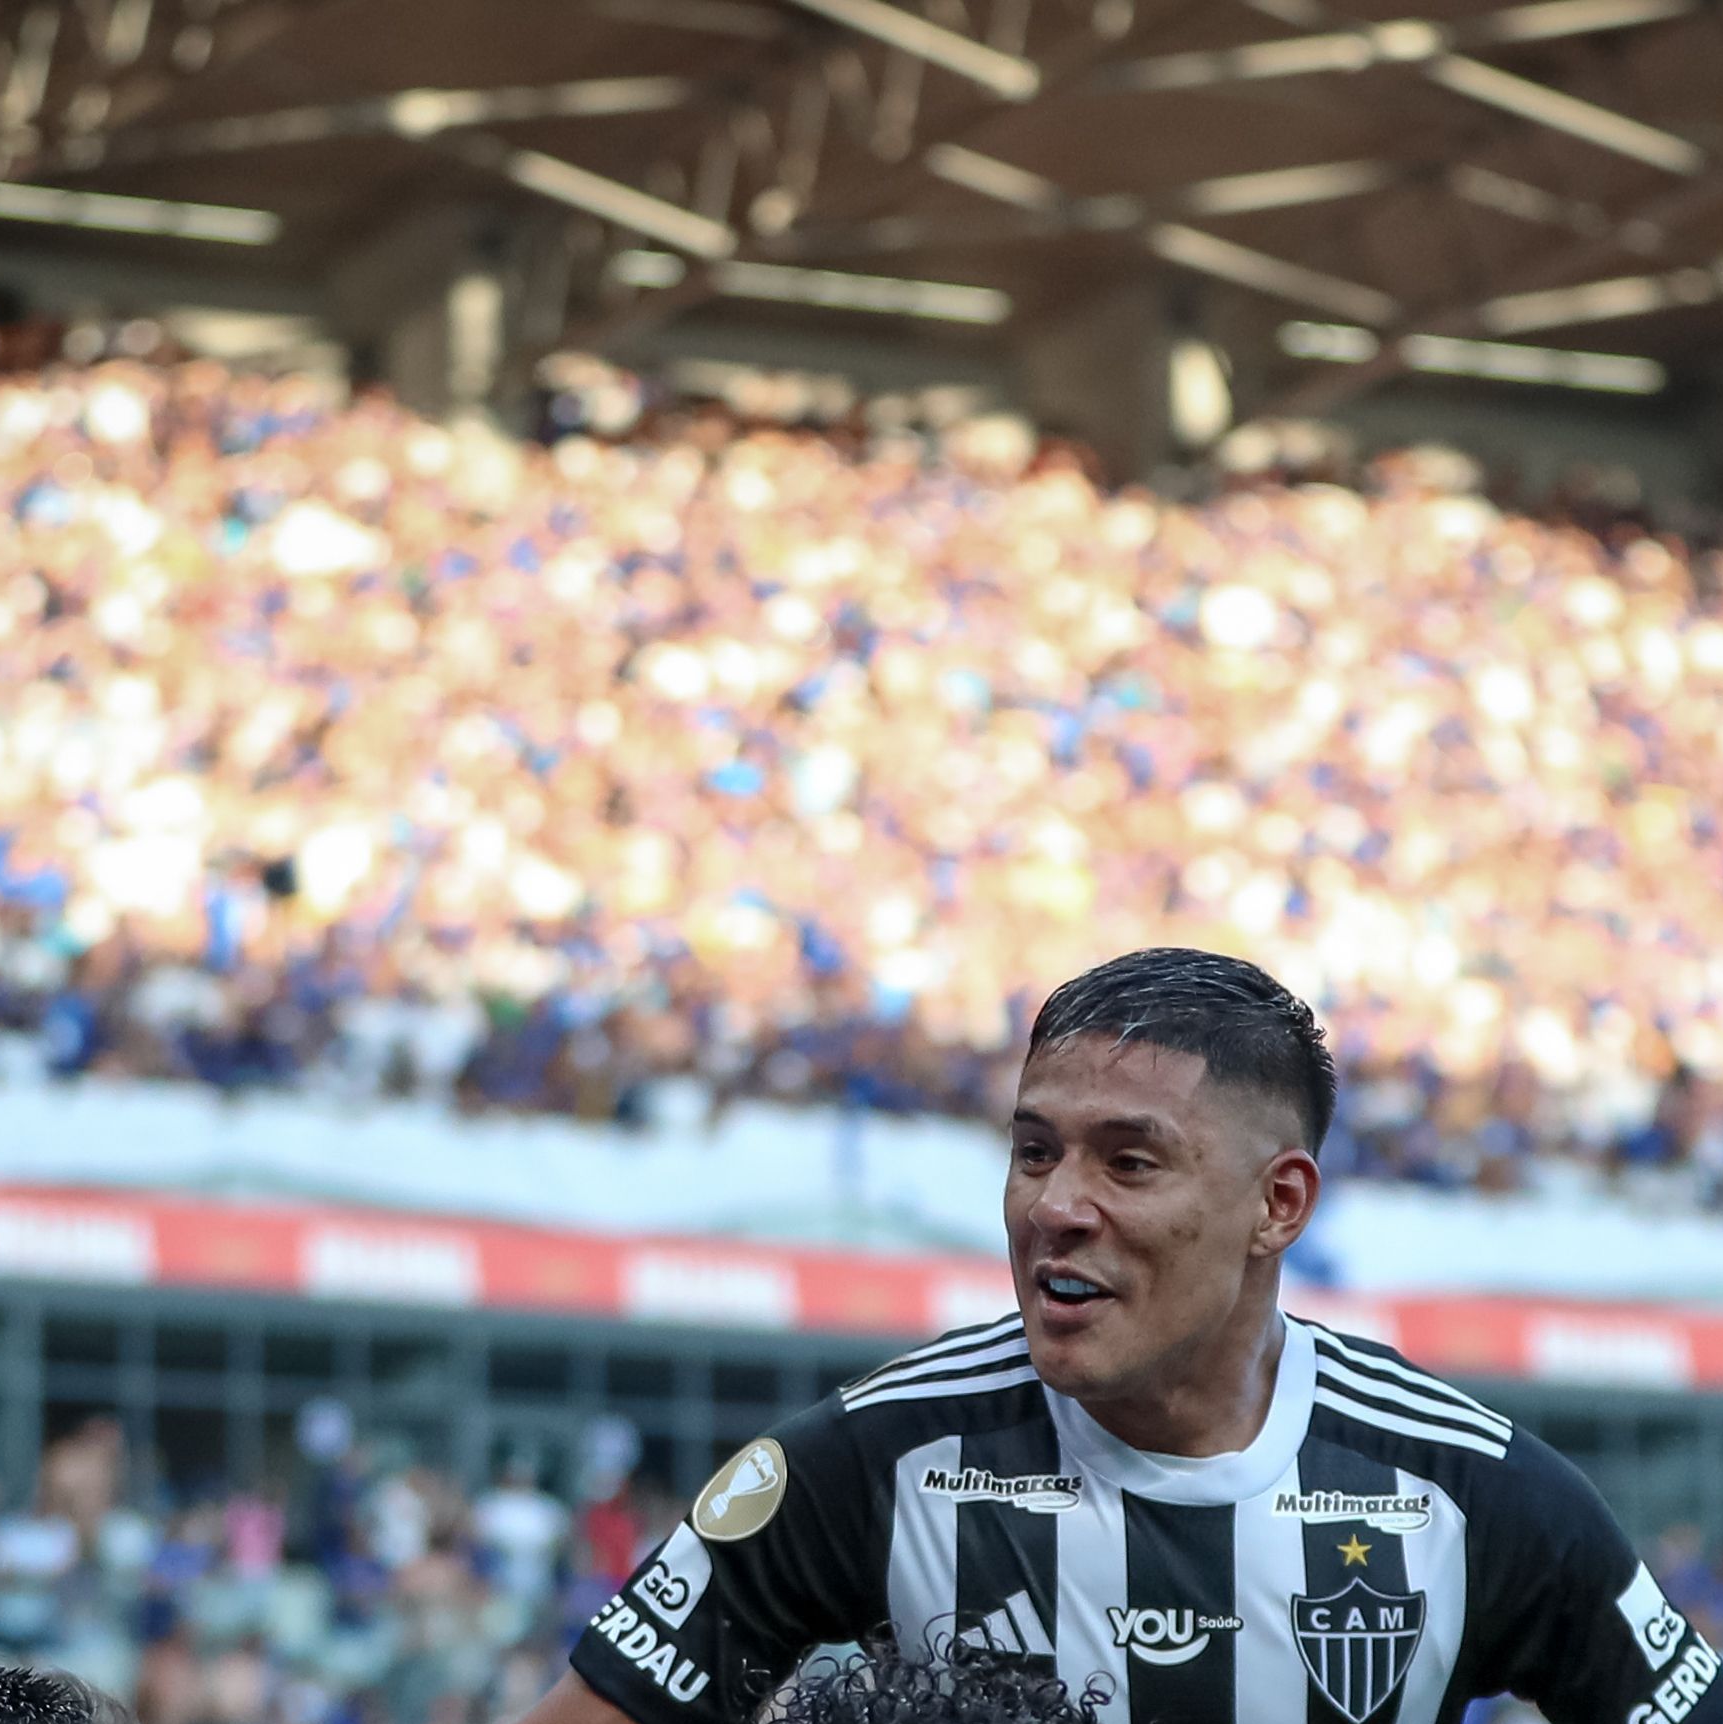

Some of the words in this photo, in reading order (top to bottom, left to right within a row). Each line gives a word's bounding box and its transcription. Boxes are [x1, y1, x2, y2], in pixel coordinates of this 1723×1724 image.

[924, 1469, 1083, 1493] Multimarcas
[1275, 1493, 1431, 1514] Multimarcas
[1108, 1607, 1195, 1645] YOU
[1198, 1615, 1243, 1629] Saúde
[590, 1594, 710, 1702] RDAU
